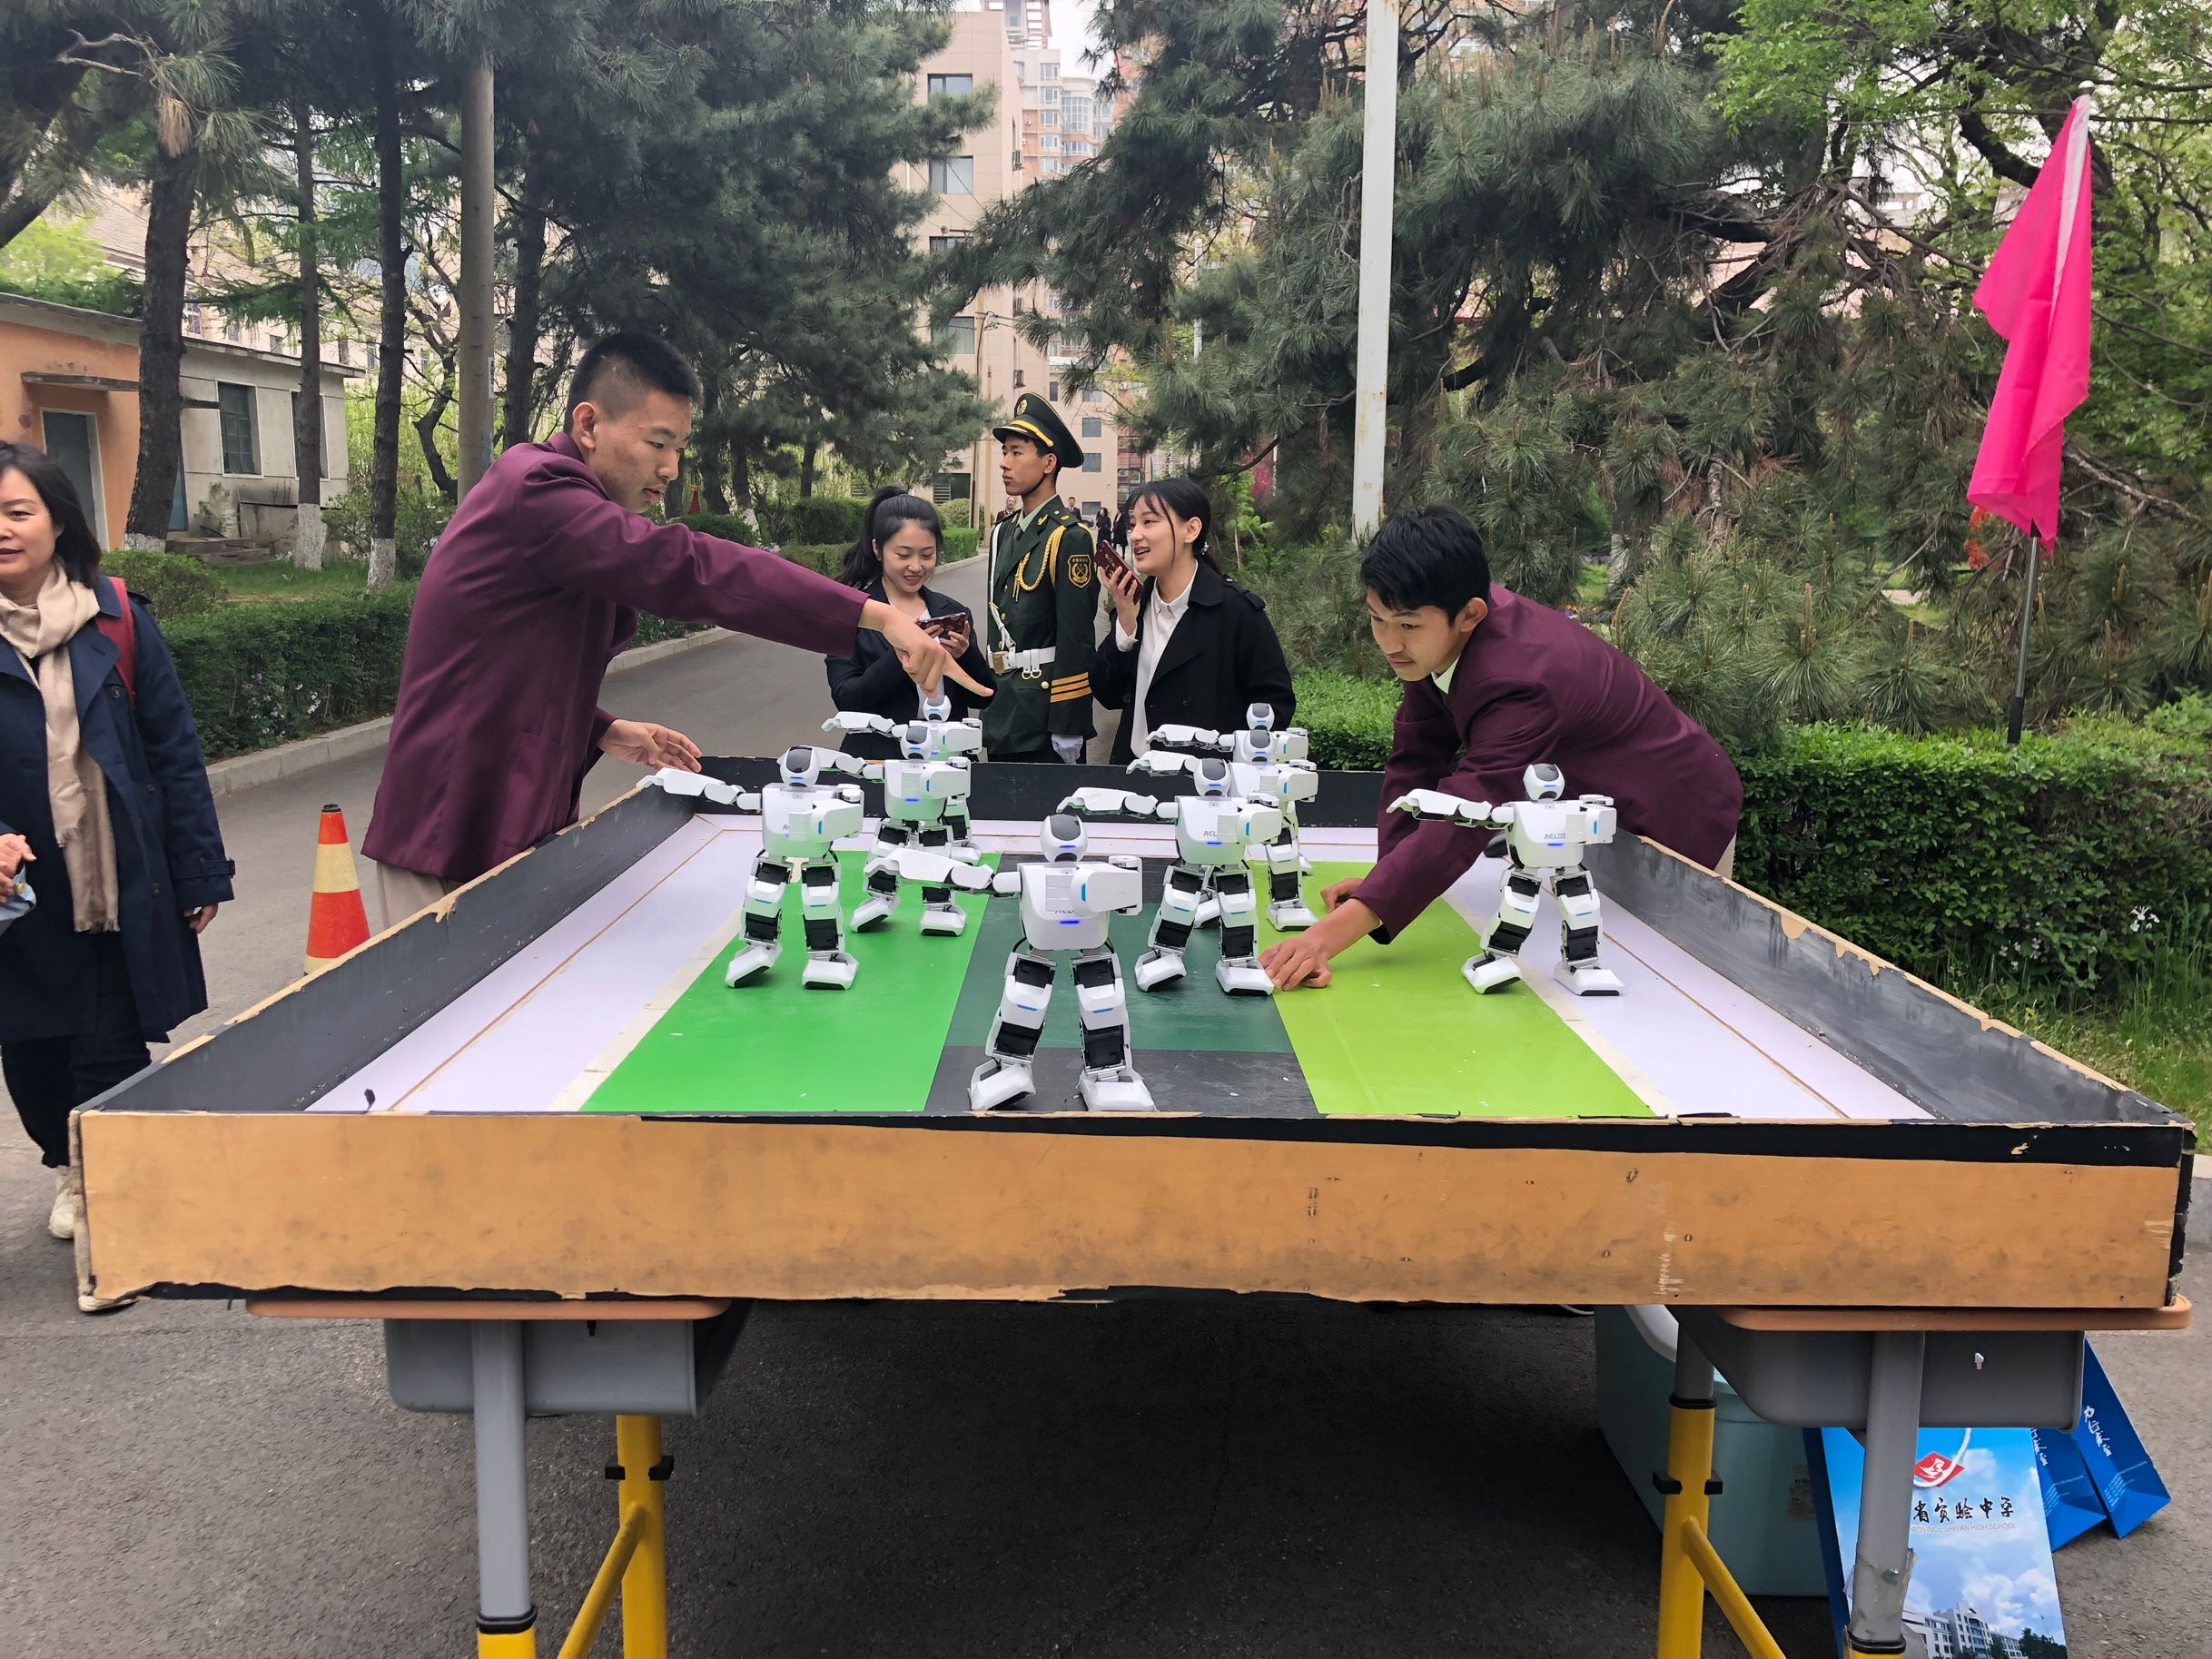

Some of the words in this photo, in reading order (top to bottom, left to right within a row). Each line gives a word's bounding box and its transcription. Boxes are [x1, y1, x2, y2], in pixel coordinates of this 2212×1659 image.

[1908, 1526, 1942, 1534] PROVINCE
[1944, 1525, 1970, 1533] SHIYAN
[1970, 1524, 1987, 1532] HIGH
[1988, 1522, 2018, 1531] SCHOOL
